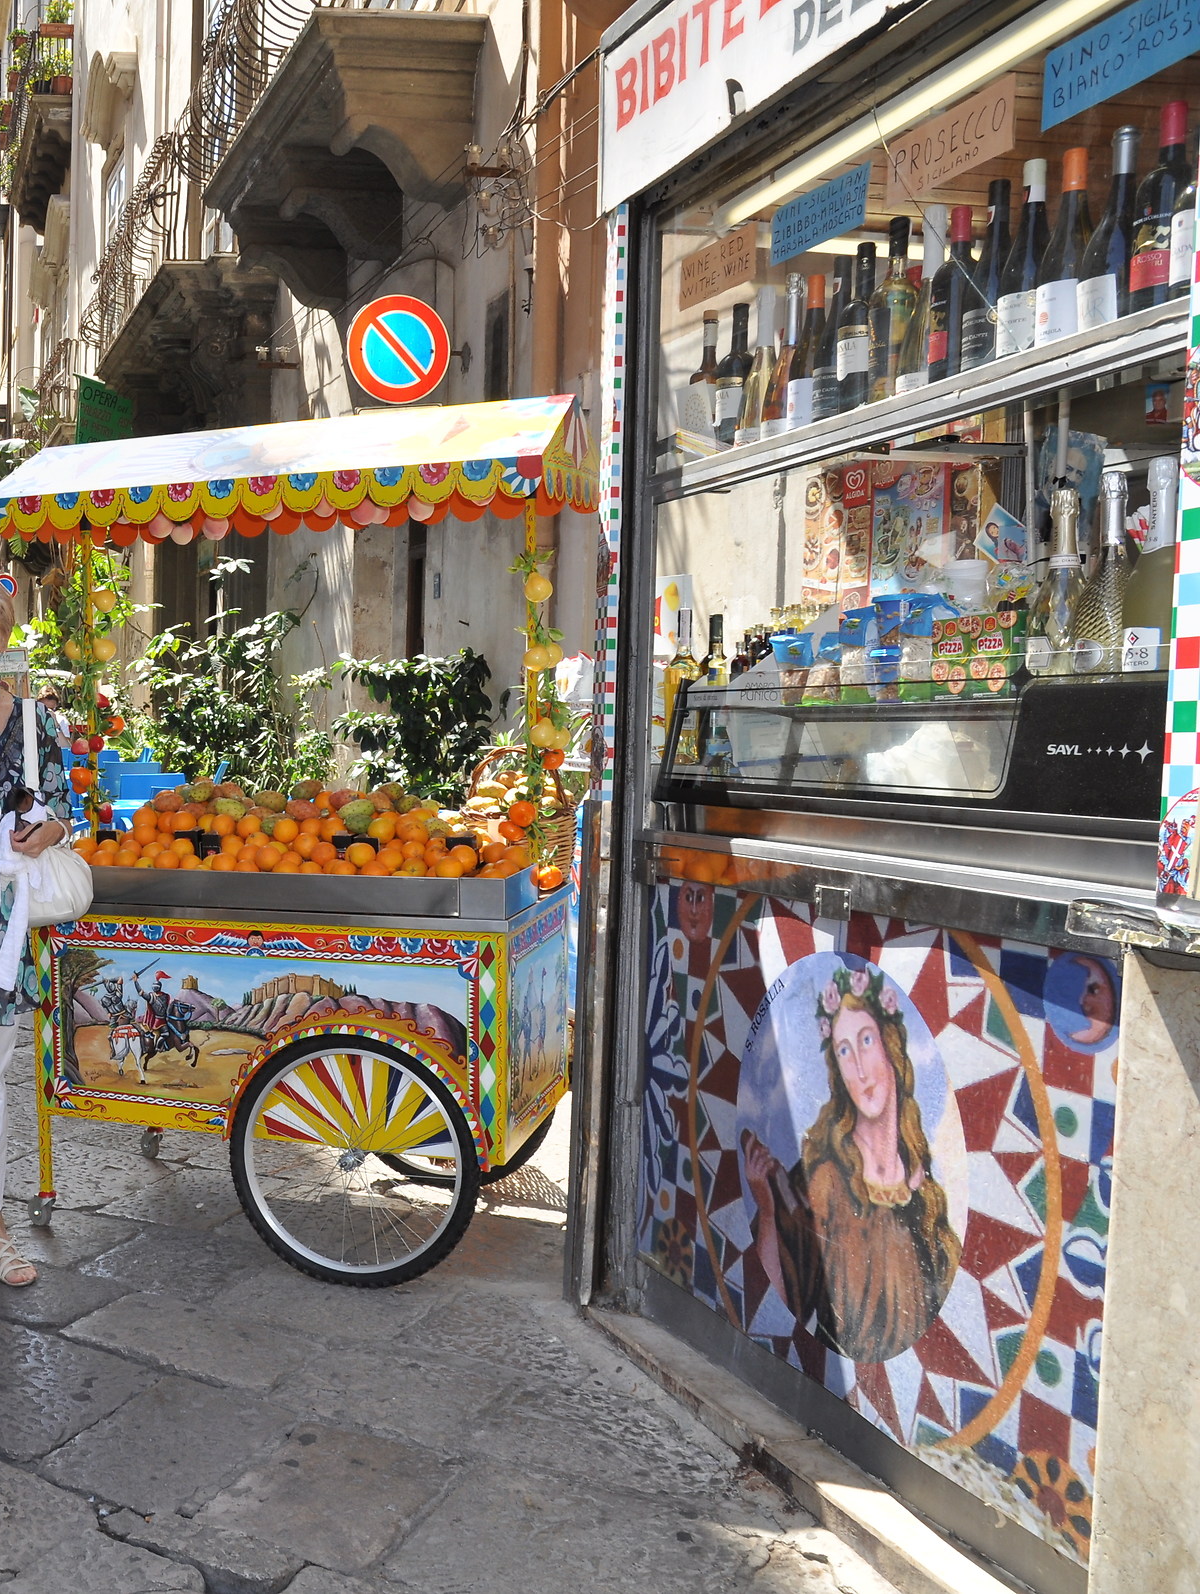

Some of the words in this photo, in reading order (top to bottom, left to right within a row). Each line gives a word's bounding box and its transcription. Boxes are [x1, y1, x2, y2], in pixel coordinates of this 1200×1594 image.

[615, 0, 744, 132] BIBITE
[894, 98, 1006, 183] PROSECCO
[83, 386, 118, 409] OPERA
[845, 490, 865, 500] ALGIDA
[740, 690, 778, 702] PUNICO
[1046, 744, 1082, 756] SAYL
[750, 978, 785, 1036] ROSALIA
